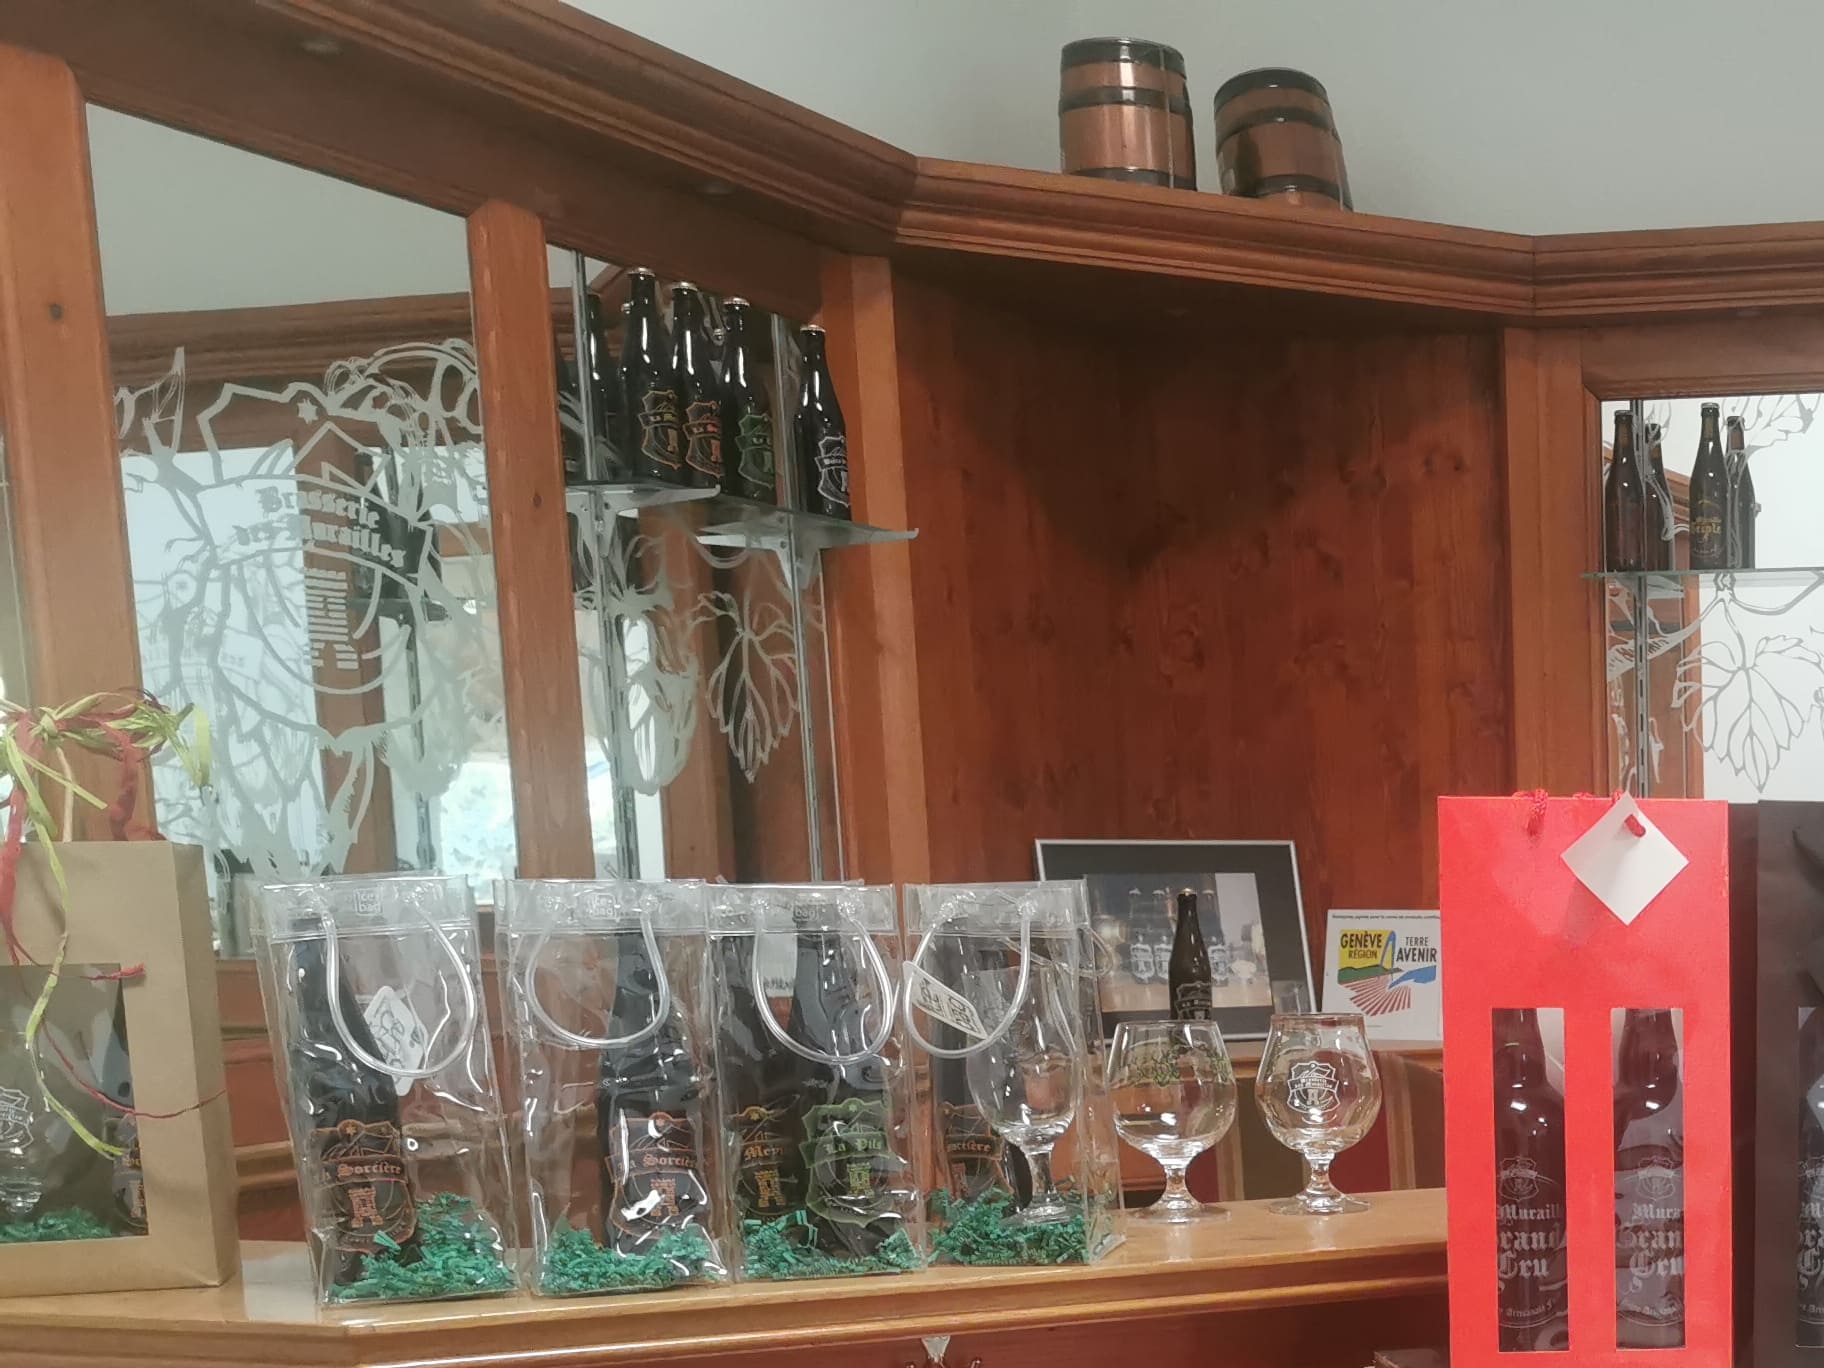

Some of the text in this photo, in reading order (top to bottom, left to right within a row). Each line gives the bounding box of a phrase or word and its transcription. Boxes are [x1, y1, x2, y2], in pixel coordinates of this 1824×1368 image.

[1340, 932, 1429, 948] GENÈVE TERRE
[1396, 948, 1437, 962] AVENIR
[1632, 1202, 1684, 1221] Mura
[1616, 1222, 1683, 1250] Gran
